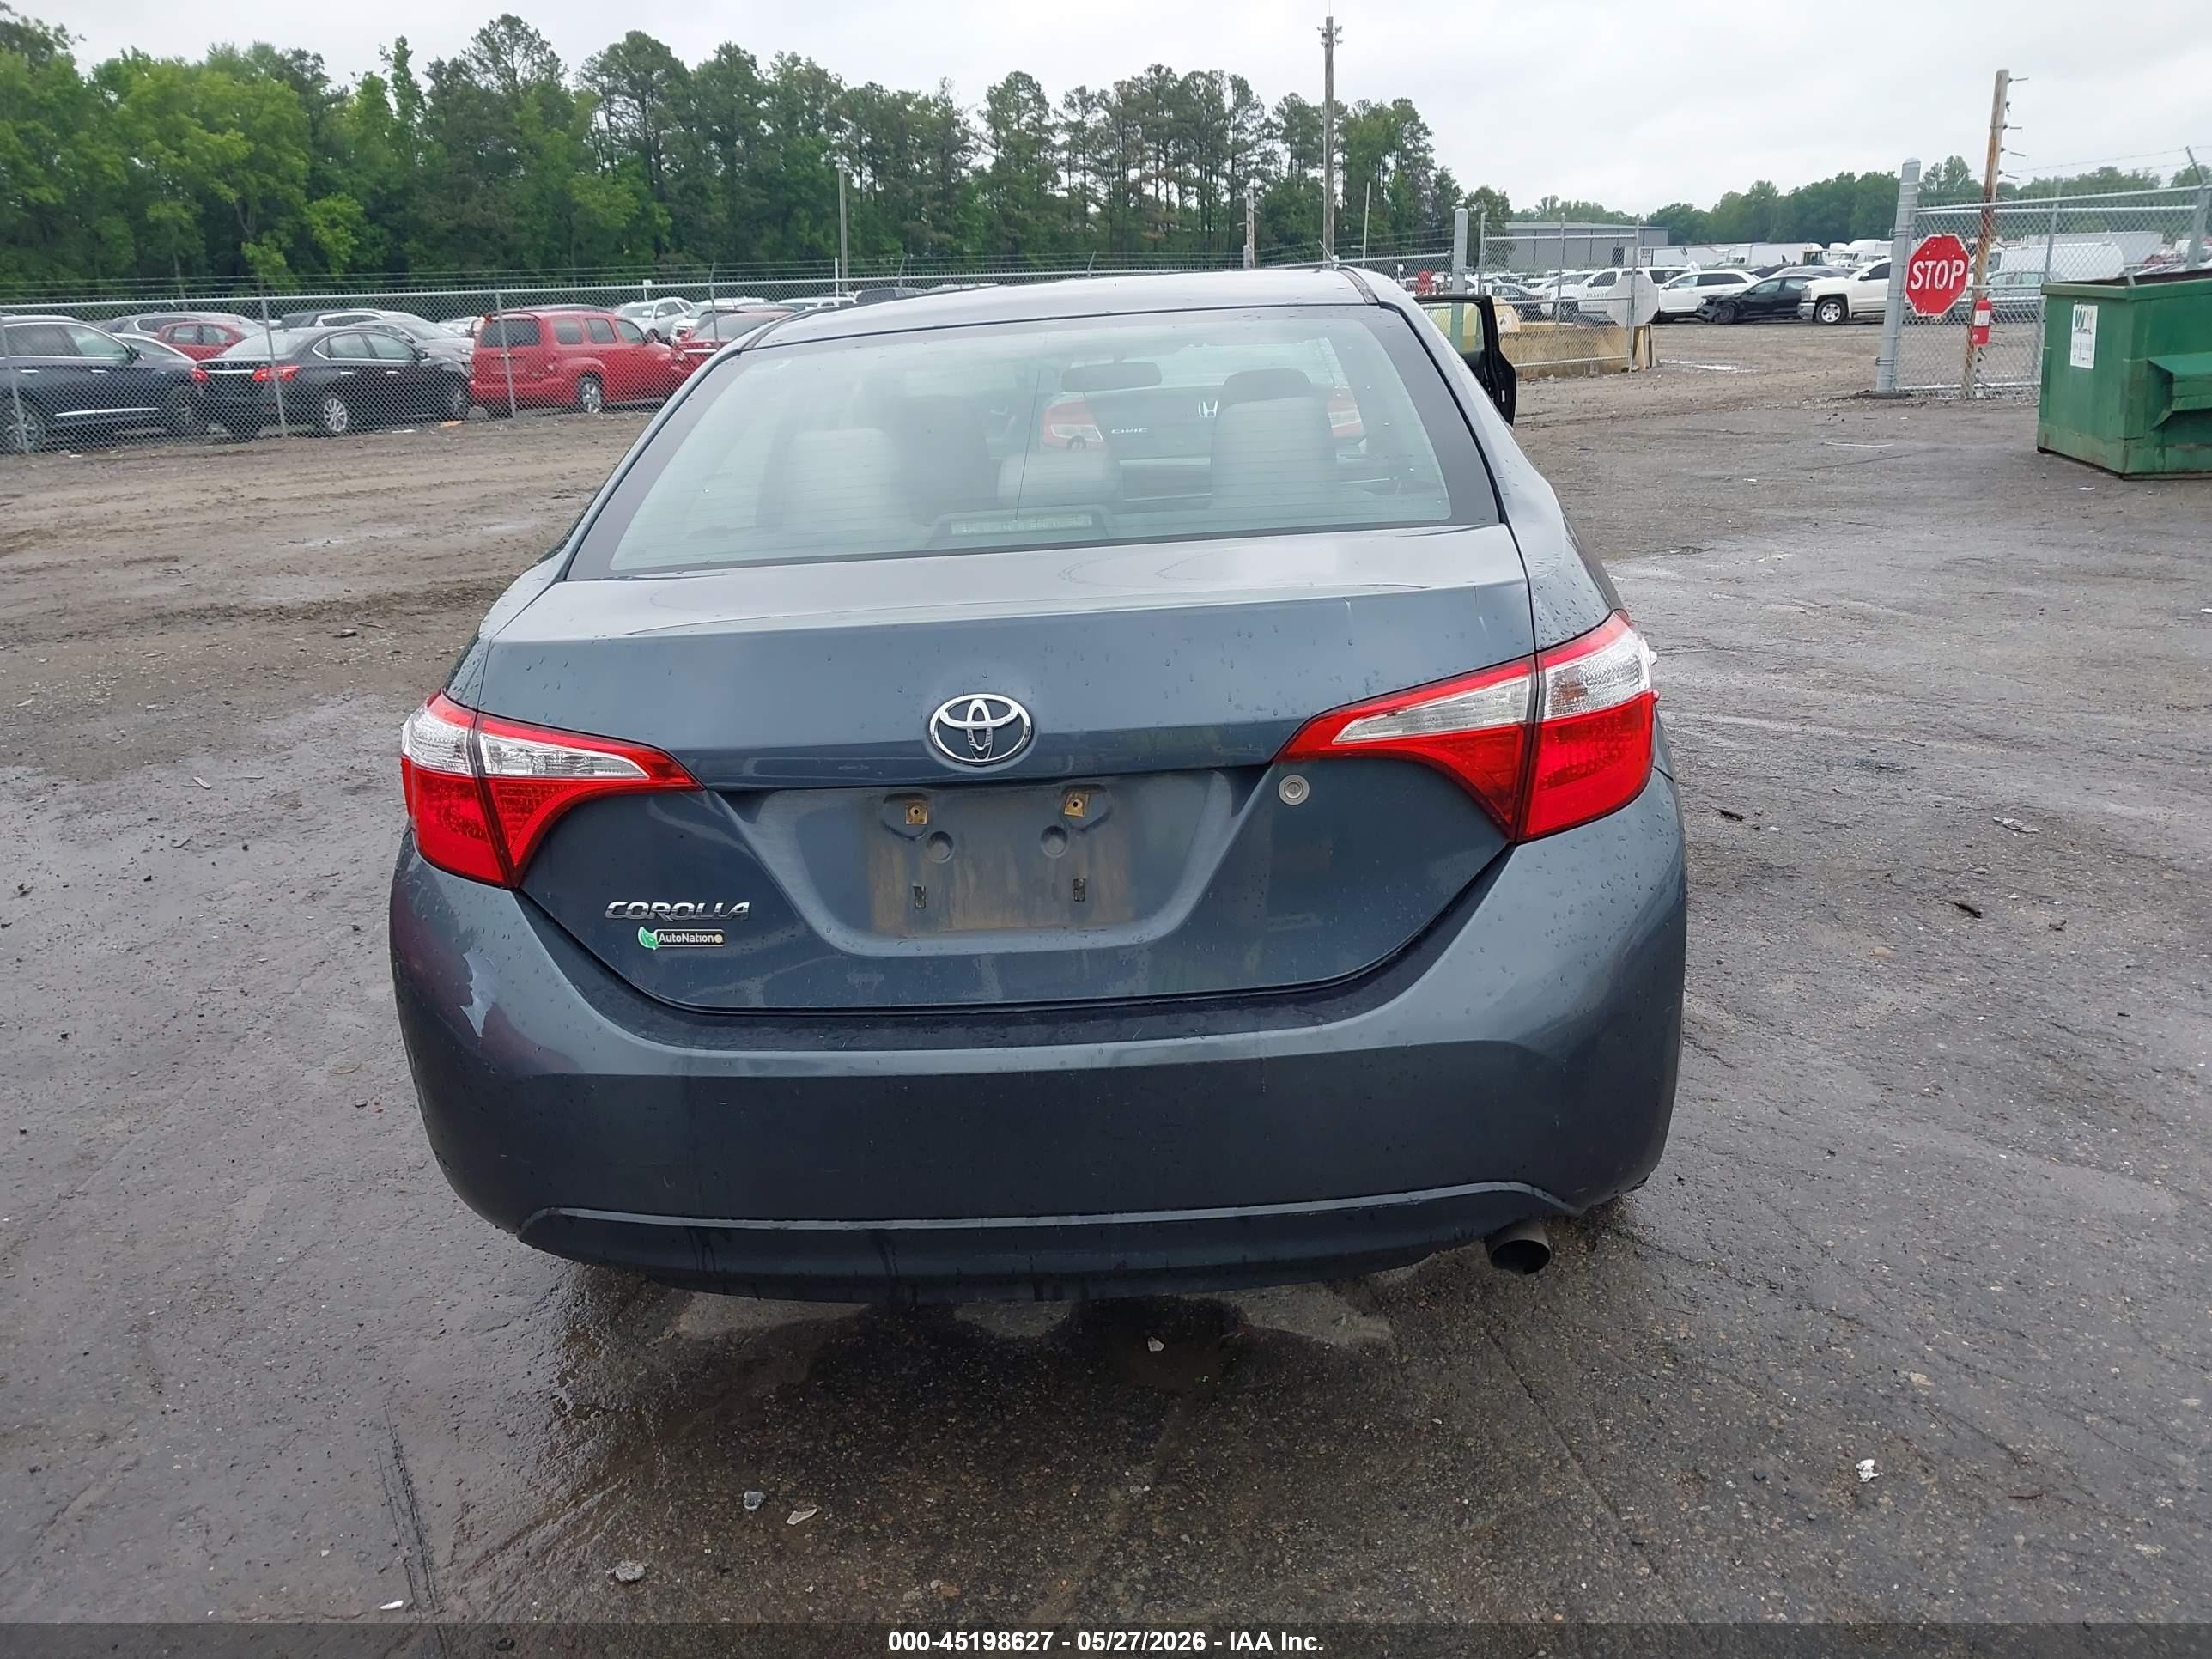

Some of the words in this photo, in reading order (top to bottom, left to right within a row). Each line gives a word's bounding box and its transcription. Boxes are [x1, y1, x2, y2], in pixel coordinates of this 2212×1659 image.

[1910, 259, 1966, 290] STOP
[605, 900, 751, 921] COROLLA
[659, 932, 714, 944] AutoNation
